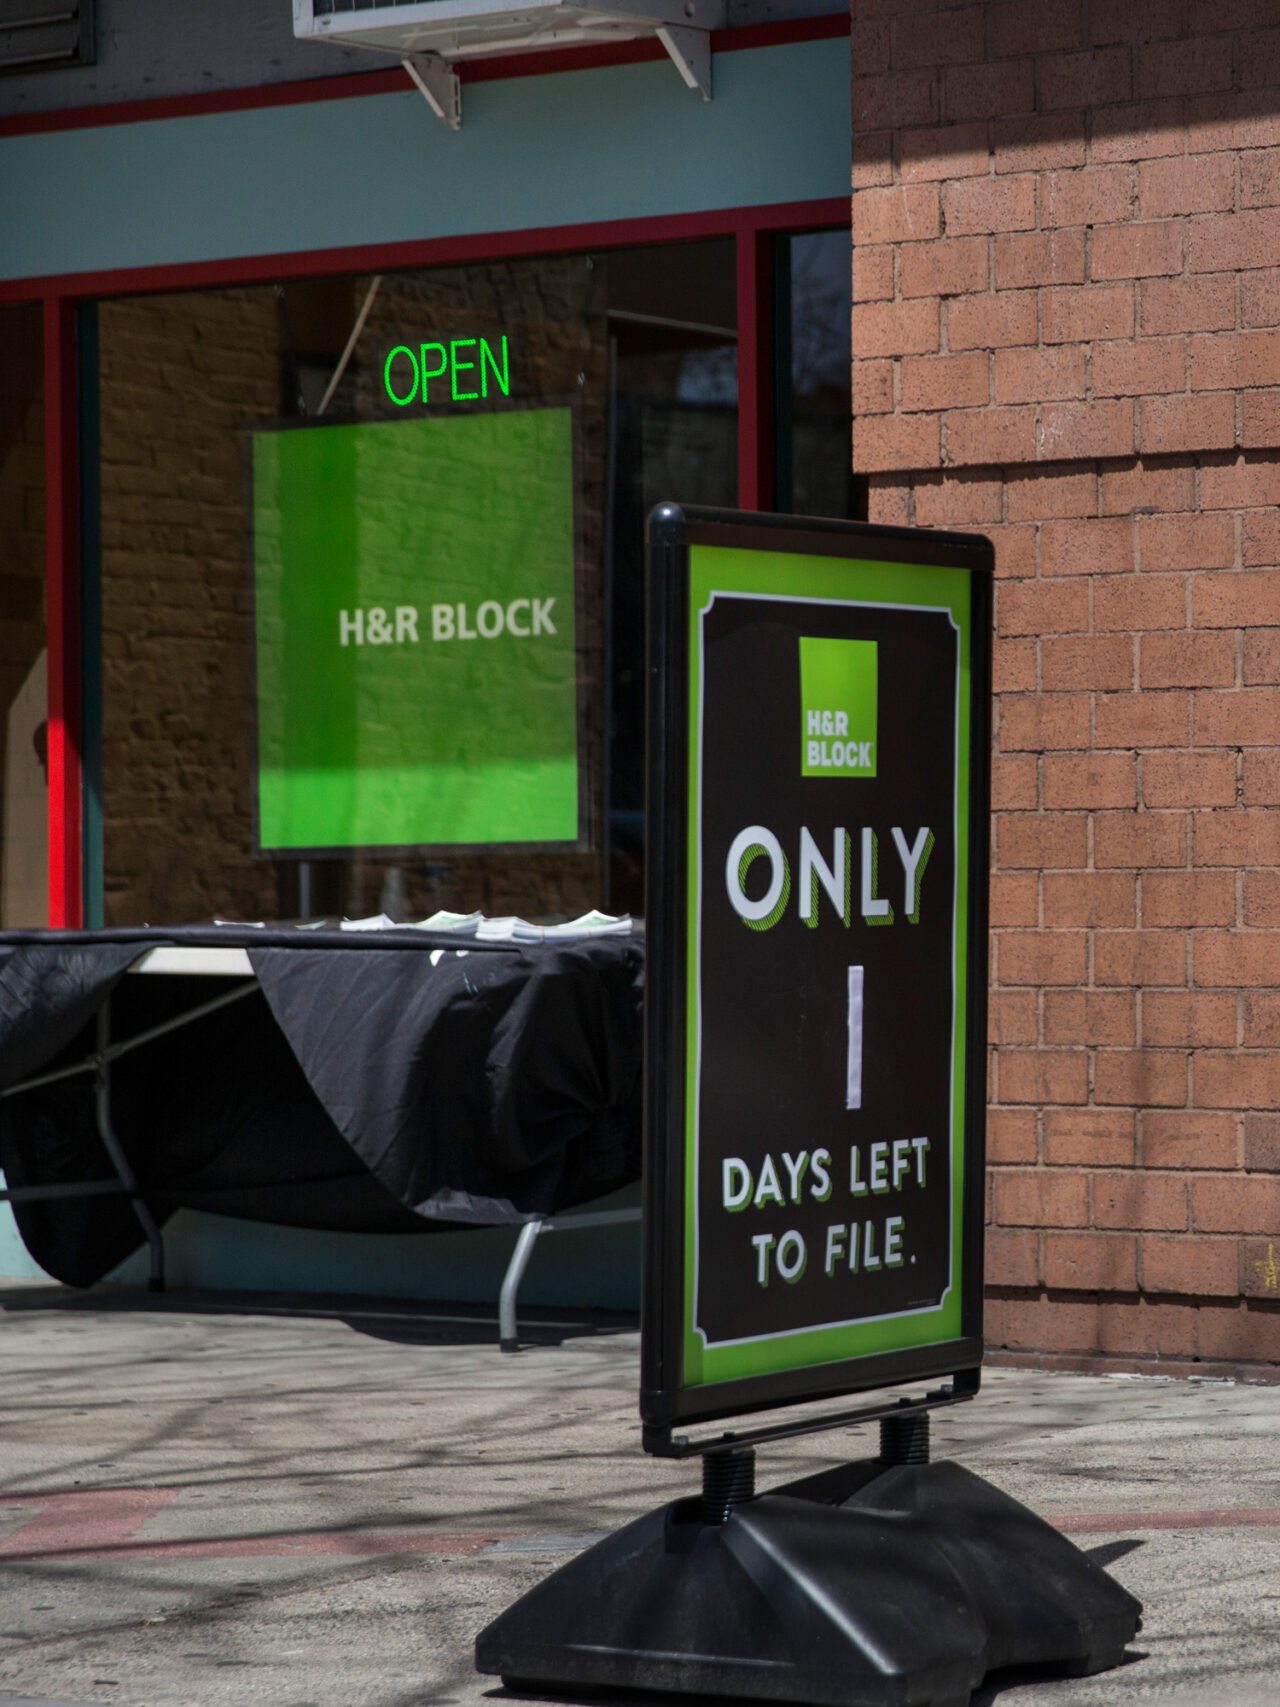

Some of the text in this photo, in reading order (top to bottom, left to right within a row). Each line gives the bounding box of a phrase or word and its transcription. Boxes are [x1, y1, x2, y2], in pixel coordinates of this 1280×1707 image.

[384, 335, 509, 405] OPEN
[338, 597, 558, 647] H&R BLOCK
[806, 709, 873, 768] H&R BLOCK
[725, 825, 935, 931] ONLY
[722, 1136, 931, 1212] DAYS LEFT
[751, 1216, 917, 1288] TO FILE.
